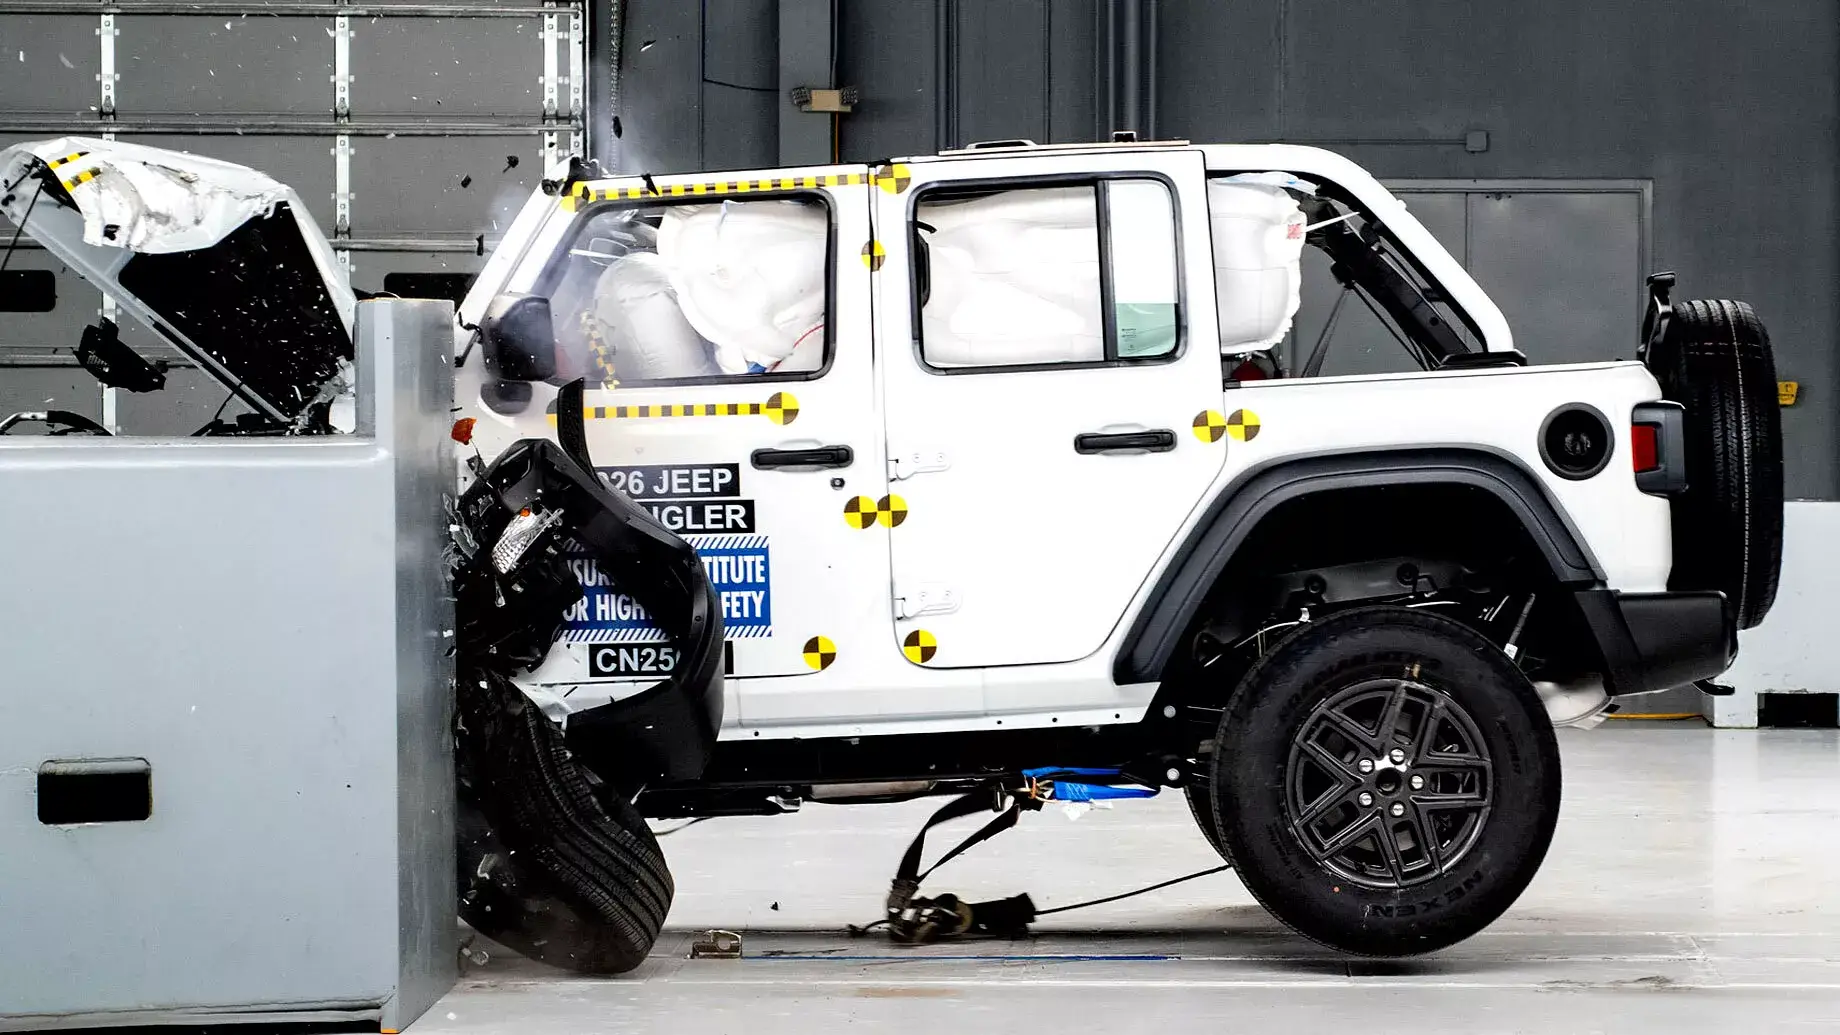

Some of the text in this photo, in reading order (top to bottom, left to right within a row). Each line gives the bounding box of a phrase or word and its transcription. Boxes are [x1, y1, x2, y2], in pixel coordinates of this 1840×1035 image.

[597, 468, 733, 495] 26 JEEP
[595, 593, 652, 621] HIGH
[720, 590, 765, 619] FETY
[596, 647, 681, 673] CN25
[1369, 870, 1484, 918] NEXEN
